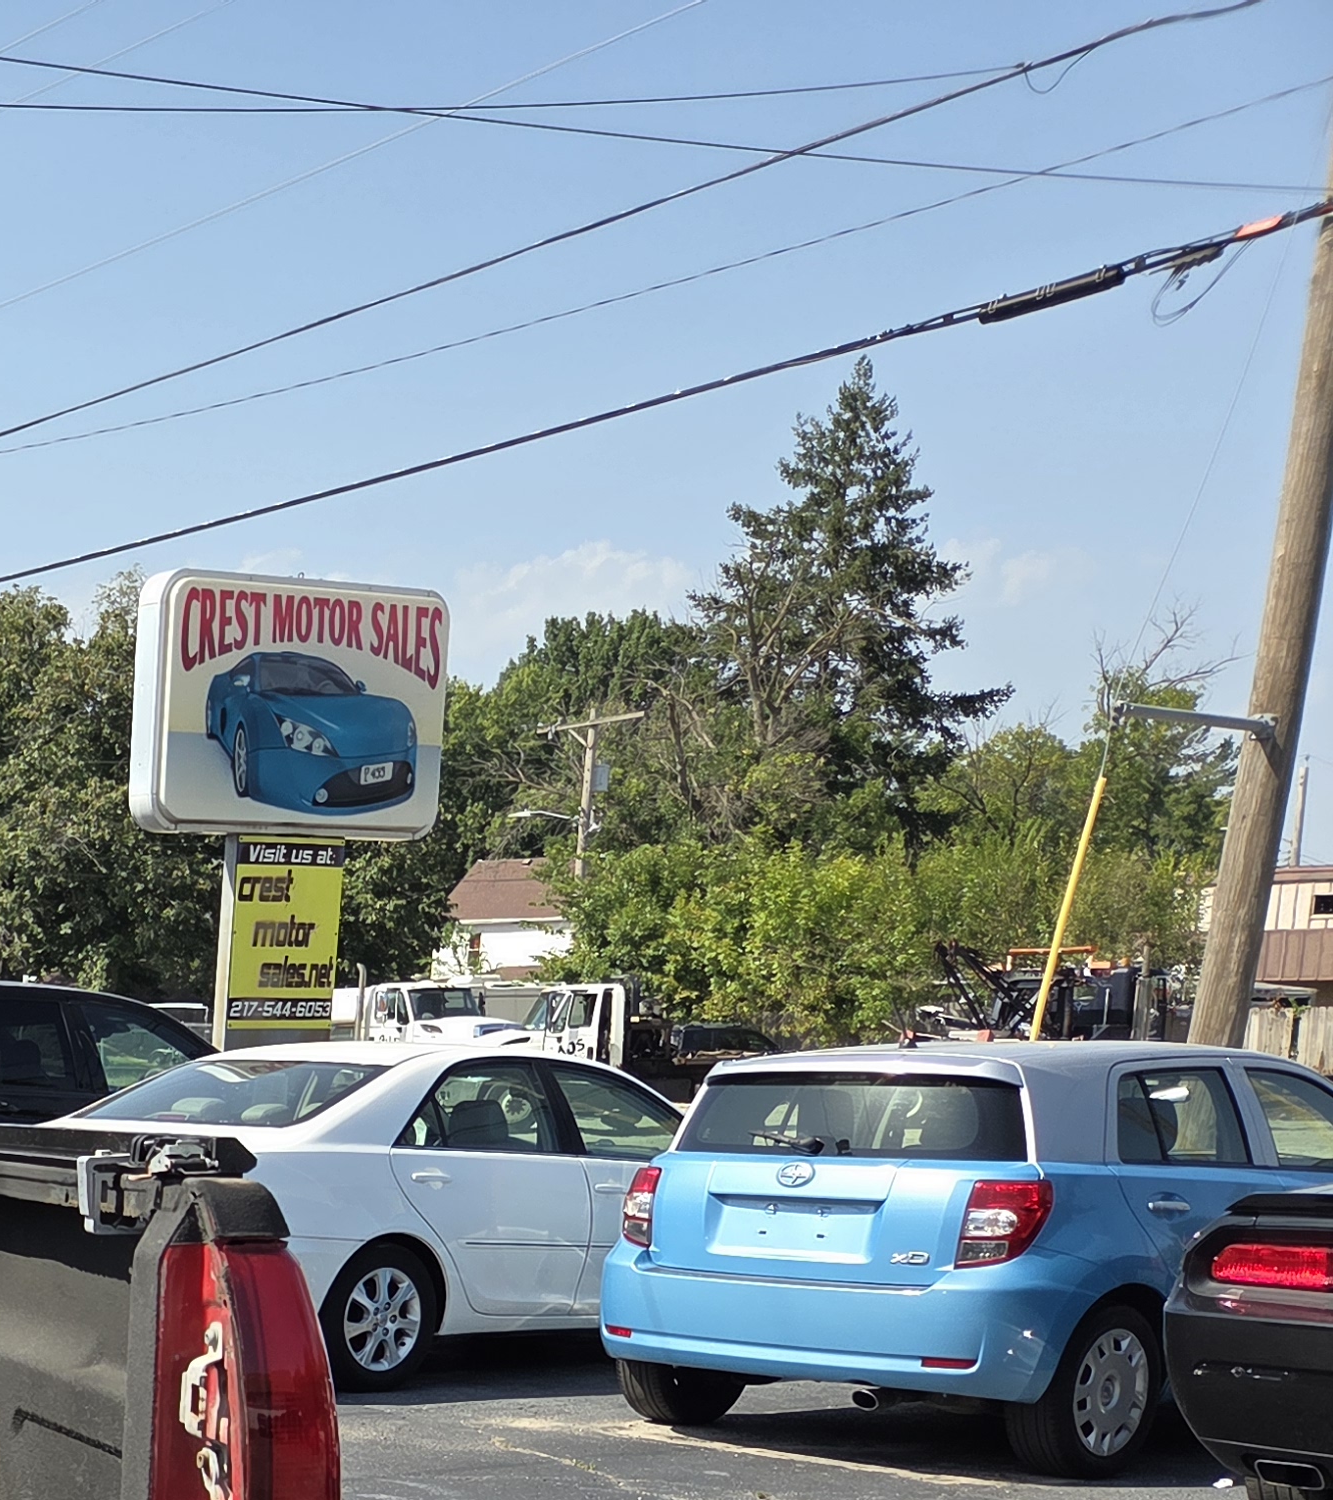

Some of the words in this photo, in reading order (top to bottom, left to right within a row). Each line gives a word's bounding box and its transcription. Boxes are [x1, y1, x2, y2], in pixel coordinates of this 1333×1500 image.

[180, 586, 267, 672] CREST
[272, 593, 363, 651] MOTOR
[370, 601, 443, 690] SALES
[249, 844, 287, 863] Visit
[290, 849, 313, 864] us
[316, 847, 336, 864] at:
[237, 869, 294, 902] crest
[252, 914, 316, 948] motor
[258, 955, 333, 988] sales.net
[229, 1001, 332, 1018] 217-544-6053
